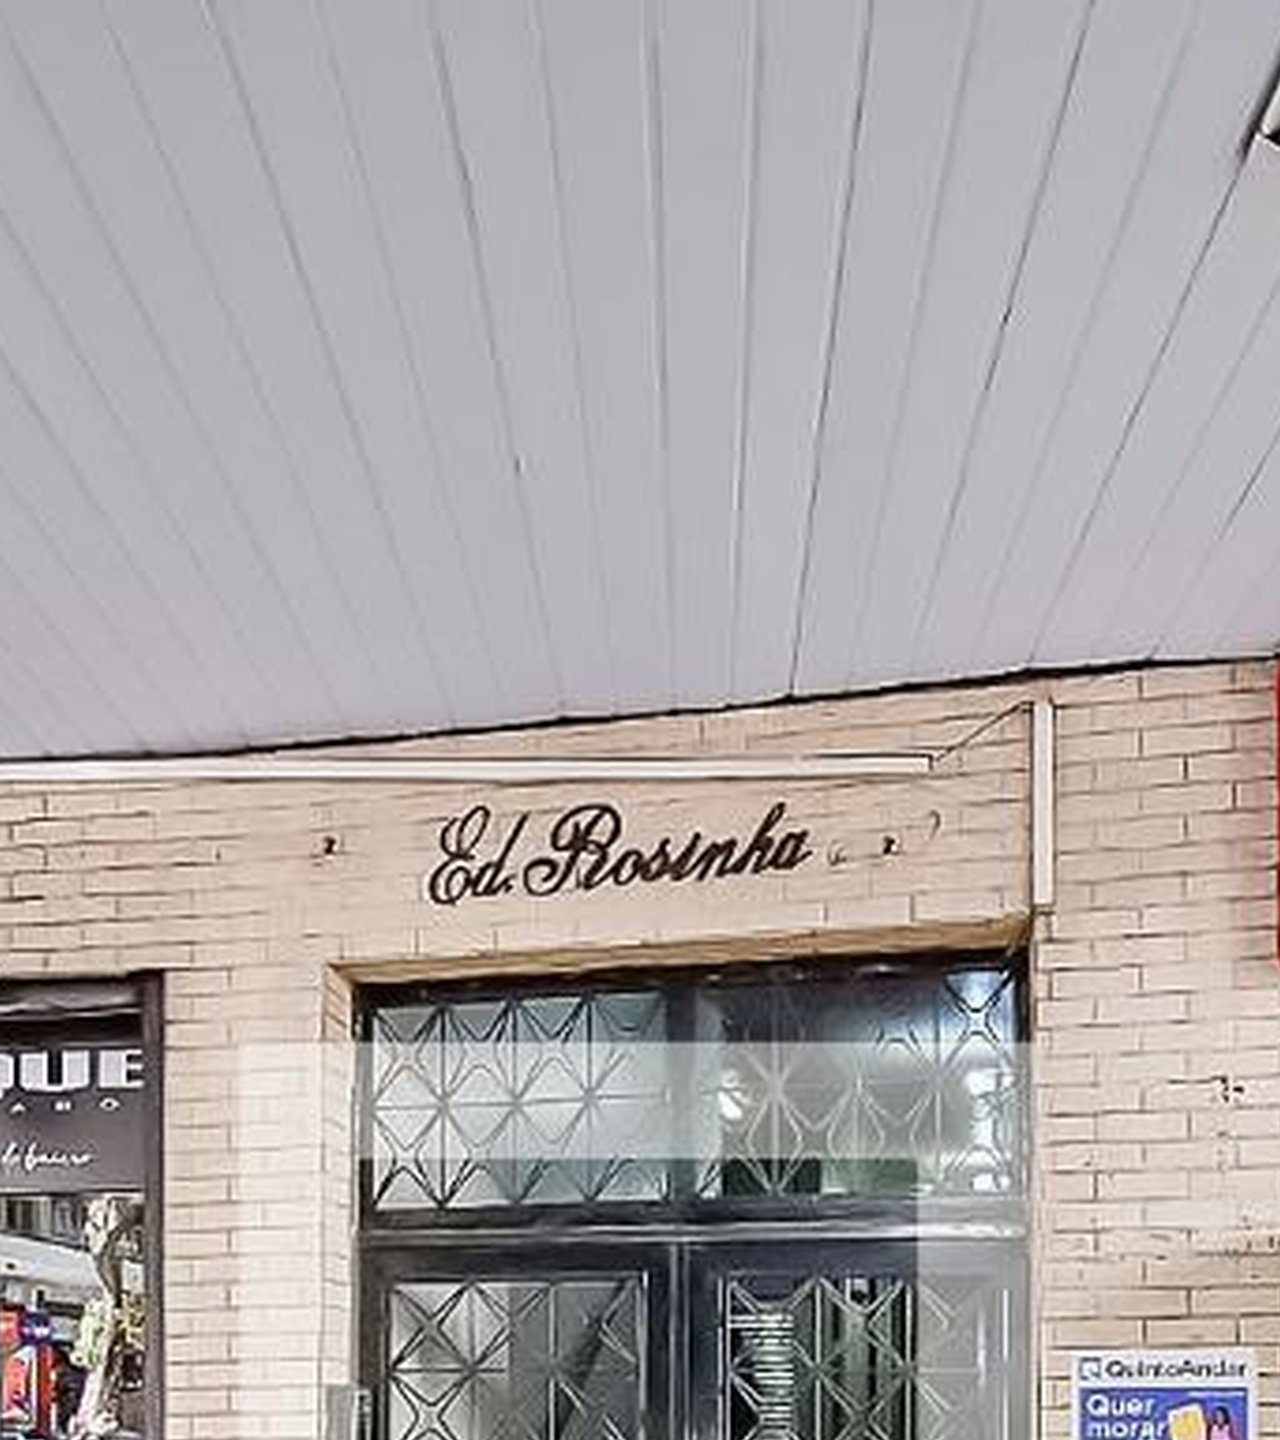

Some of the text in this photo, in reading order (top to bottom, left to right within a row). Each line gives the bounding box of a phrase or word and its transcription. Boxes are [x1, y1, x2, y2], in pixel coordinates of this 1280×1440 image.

[428, 800, 812, 905] Ed. Rosinha
[1086, 1393, 1156, 1418] Quer
[1087, 1418, 1166, 1439] morar
